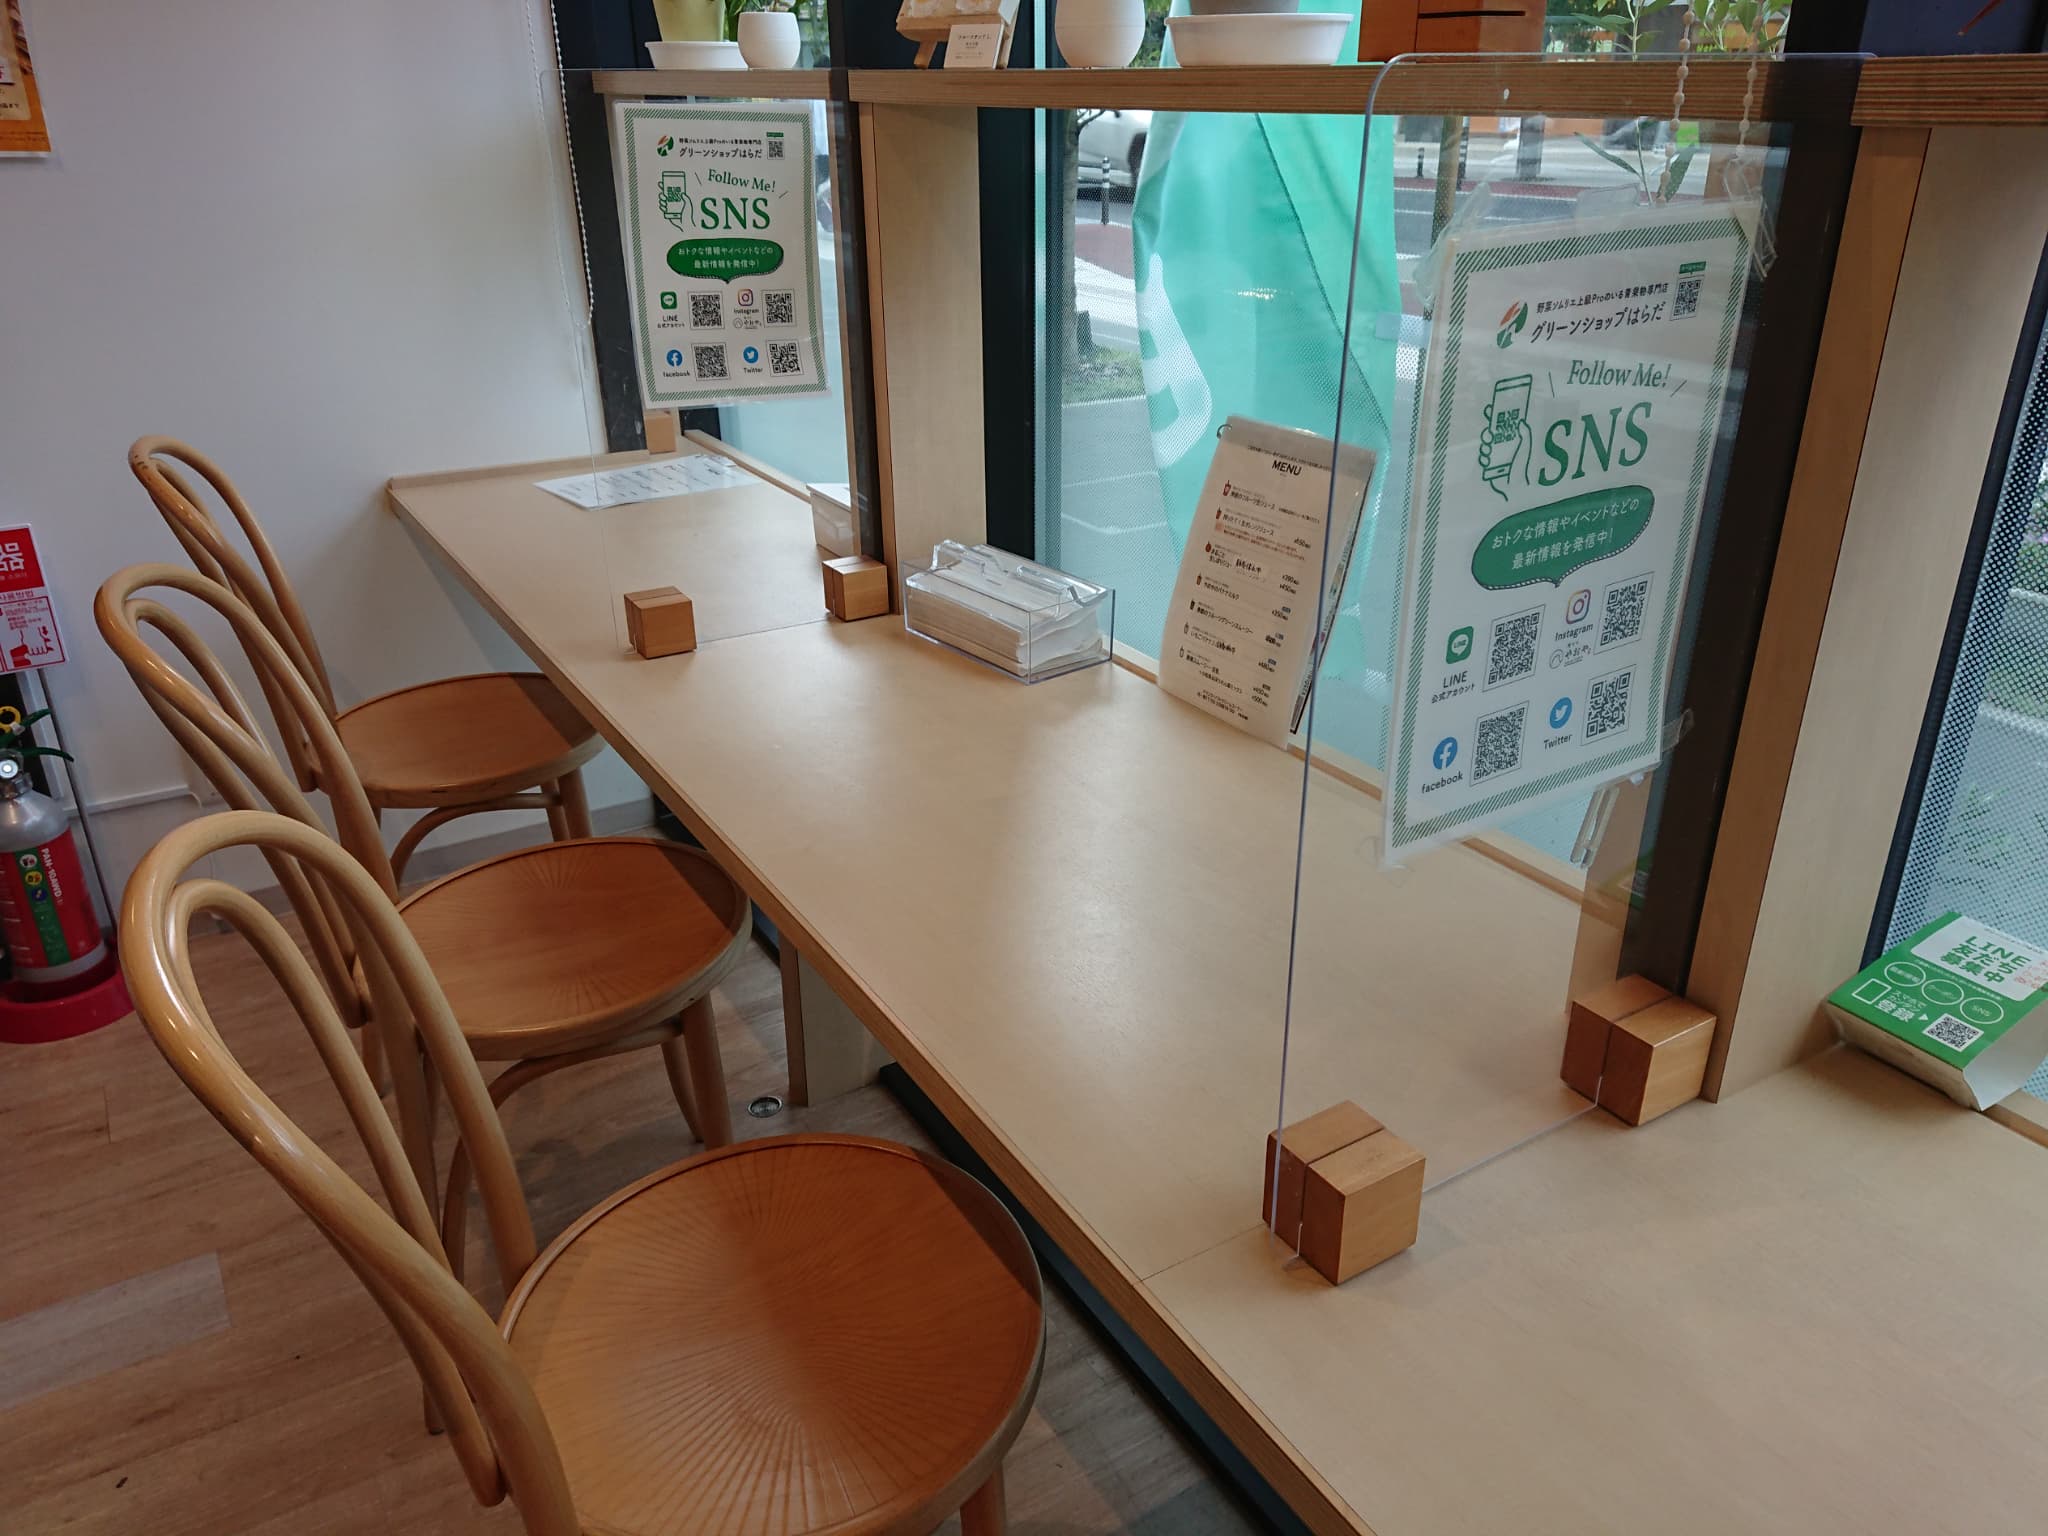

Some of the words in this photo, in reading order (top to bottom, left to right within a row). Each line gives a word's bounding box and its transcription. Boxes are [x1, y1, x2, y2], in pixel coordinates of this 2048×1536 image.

[679, 147, 762, 159] グリーンショップはらだ
[708, 168, 750, 188] Follow
[752, 177, 776, 193] Me!
[700, 197, 771, 230] SNS
[1530, 301, 1666, 343] グリーンショップはらだ
[663, 370, 690, 378] facebook
[1566, 359, 1632, 386] Follow
[1632, 363, 1672, 388] Me!
[1538, 401, 1652, 487] SNS
[1271, 459, 1302, 476] MENU
[1491, 498, 1640, 549] おトクな情報やイベントなどの
[1555, 624, 1593, 641] Instagram
[1443, 670, 1468, 688] LINE
[1431, 683, 1475, 704] 公式アカウント
[1543, 733, 1572, 750] Twitter
[1421, 771, 1463, 794] facebook
[1952, 943, 2017, 974] 友だち
[1965, 936, 2032, 967] LINE
